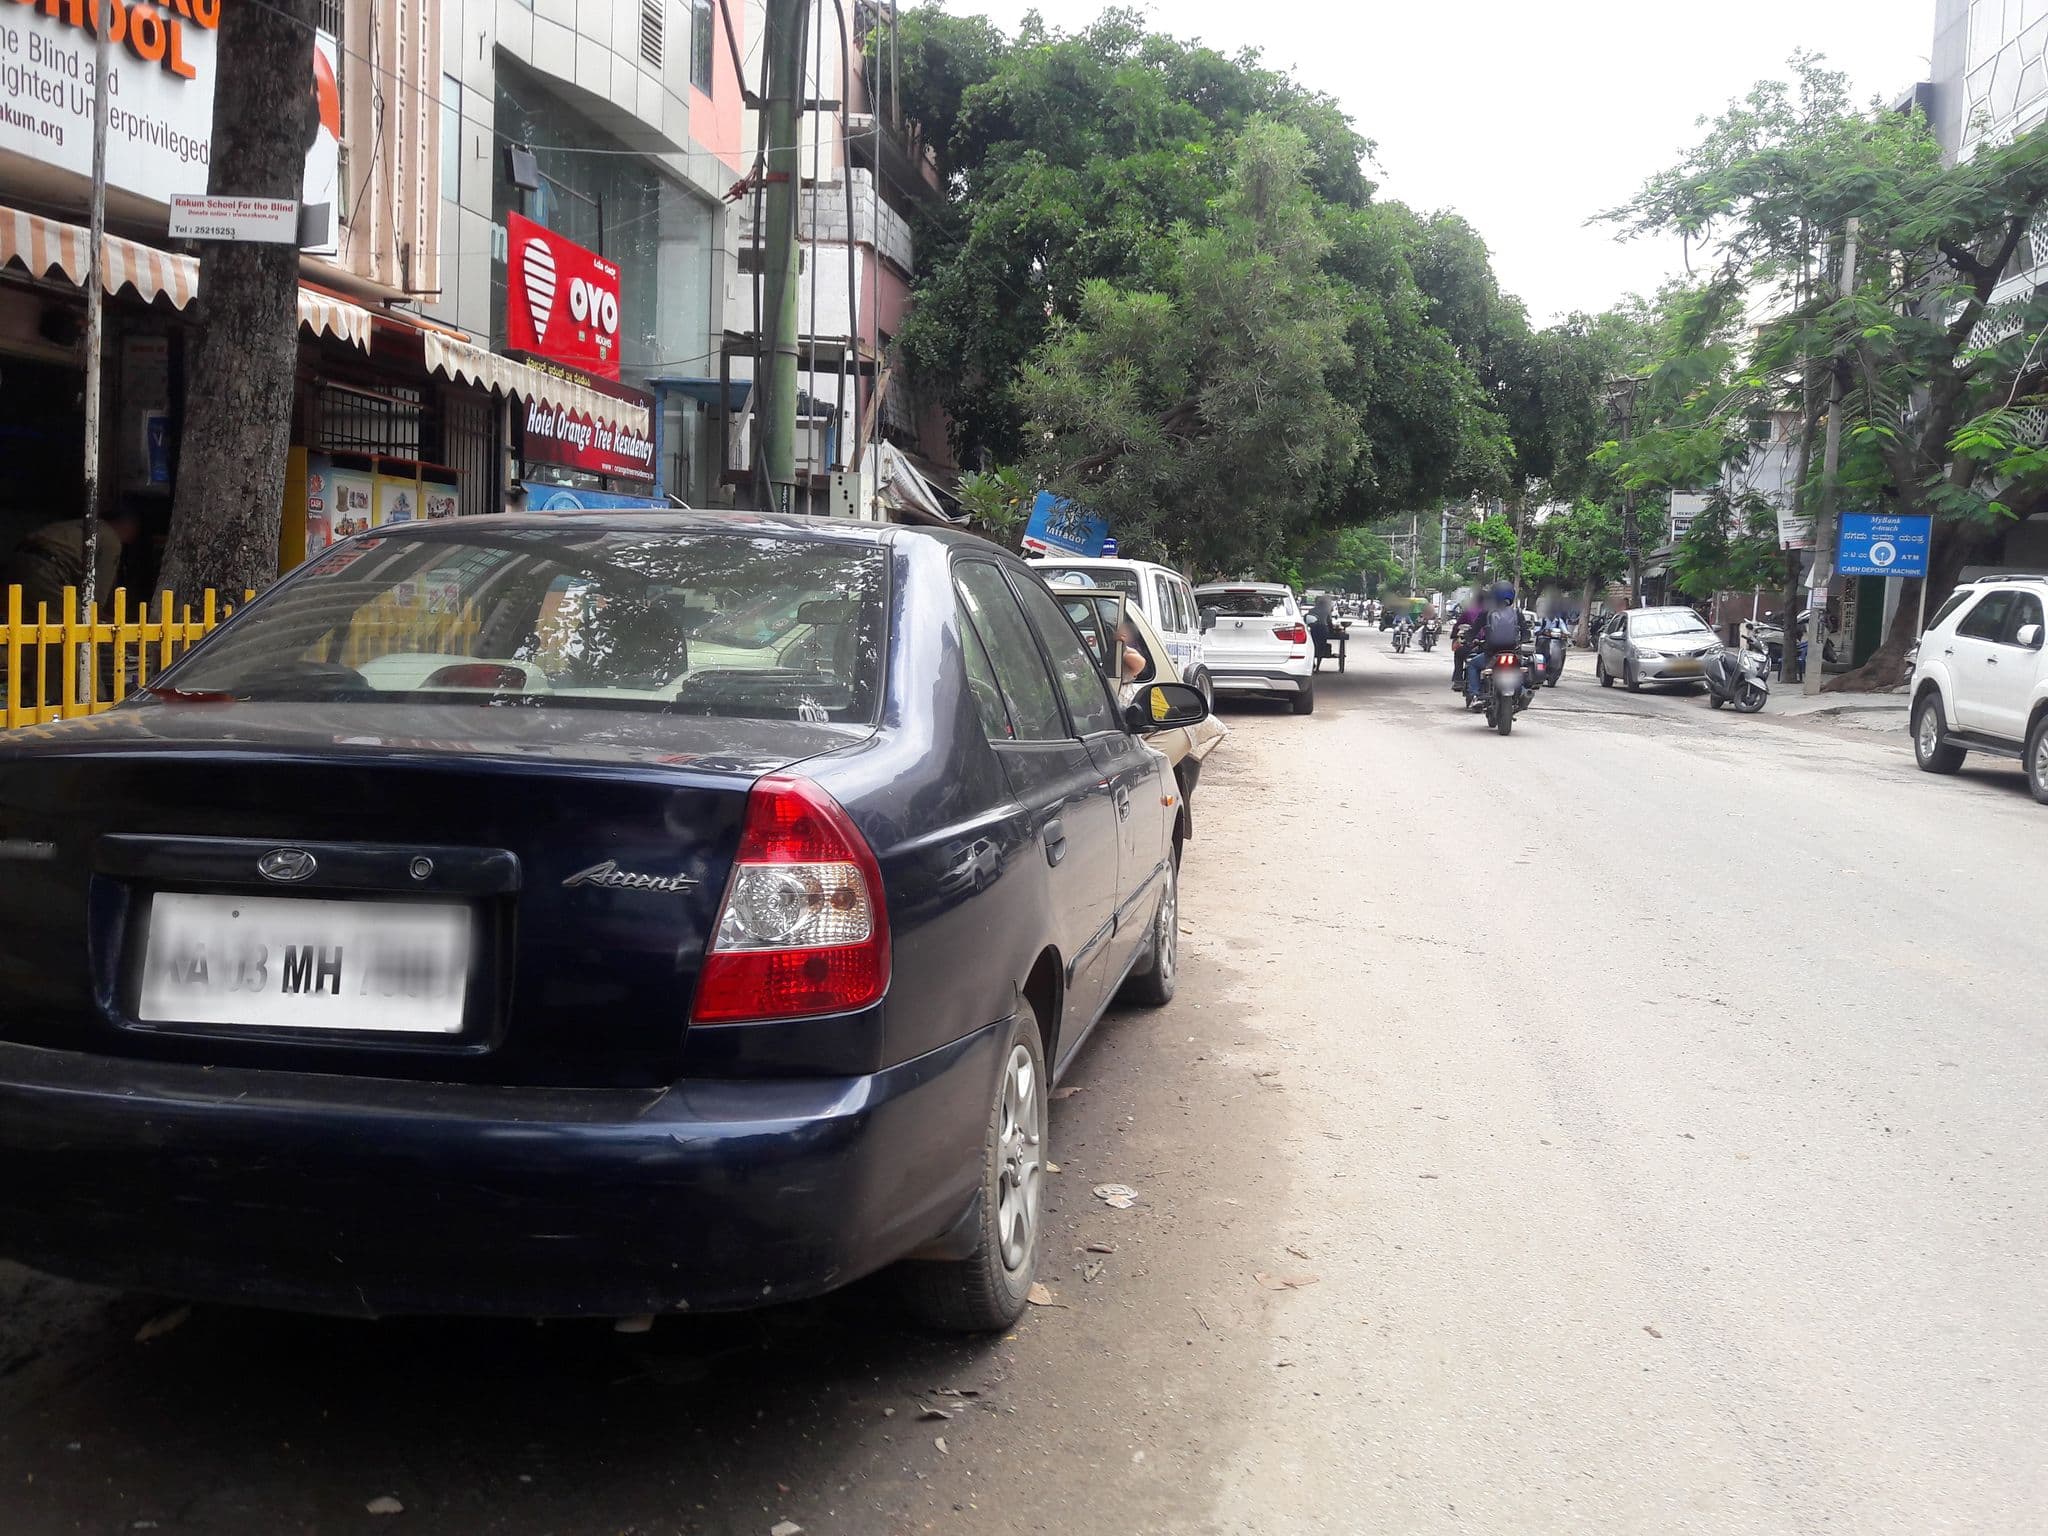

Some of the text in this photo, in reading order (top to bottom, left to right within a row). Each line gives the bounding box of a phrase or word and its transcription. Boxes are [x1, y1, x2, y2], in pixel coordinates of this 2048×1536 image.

[29, 31, 79, 79] Blind
[175, 198, 294, 212] Rakum School For the Blind
[175, 225, 188, 234] Tel
[194, 226, 236, 236] 25215253
[569, 277, 618, 335] OYO
[595, 334, 612, 349] ROOMS
[527, 403, 654, 466] Hotel Orange Tree Residency
[1891, 568, 1921, 576] MACHINE
[562, 859, 699, 893] Accent
[281, 944, 344, 996] MH
